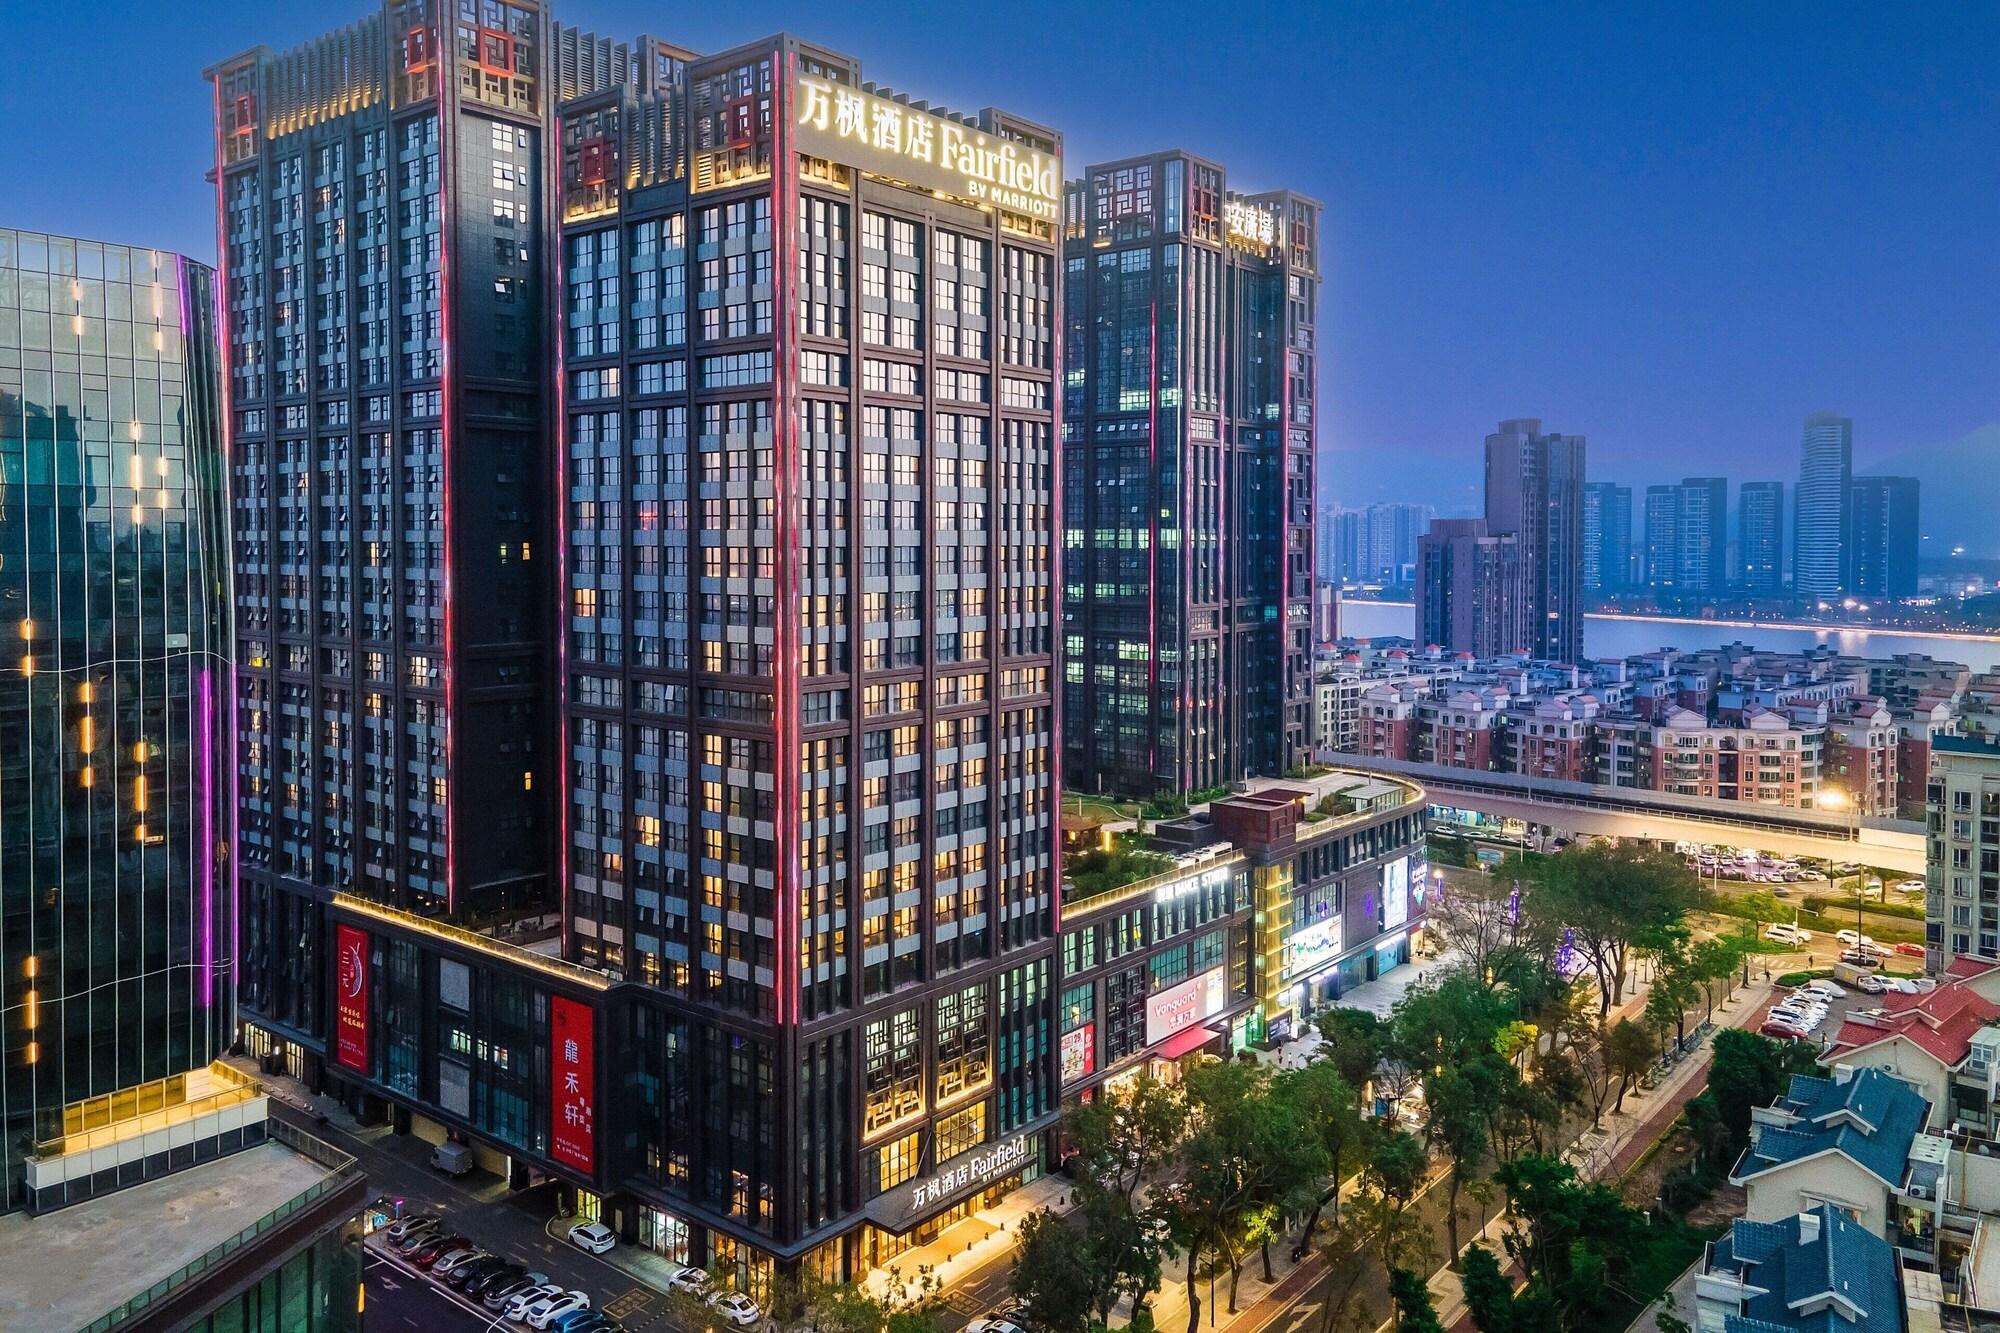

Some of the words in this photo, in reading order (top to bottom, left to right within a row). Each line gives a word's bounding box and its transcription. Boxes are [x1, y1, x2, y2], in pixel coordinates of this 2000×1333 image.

[798, 78, 934, 163] 万枫酒店
[940, 123, 1058, 200] Fairfield
[968, 180, 988, 198] BY
[991, 187, 1058, 218] MARRIOTT
[1155, 988, 1197, 1017] Vanguard
[970, 1134, 1025, 1180] Fairfield
[982, 1173, 992, 1183] BY
[993, 1155, 1026, 1177] MARRIOTT
[912, 1164, 969, 1210] 万枫酒店
